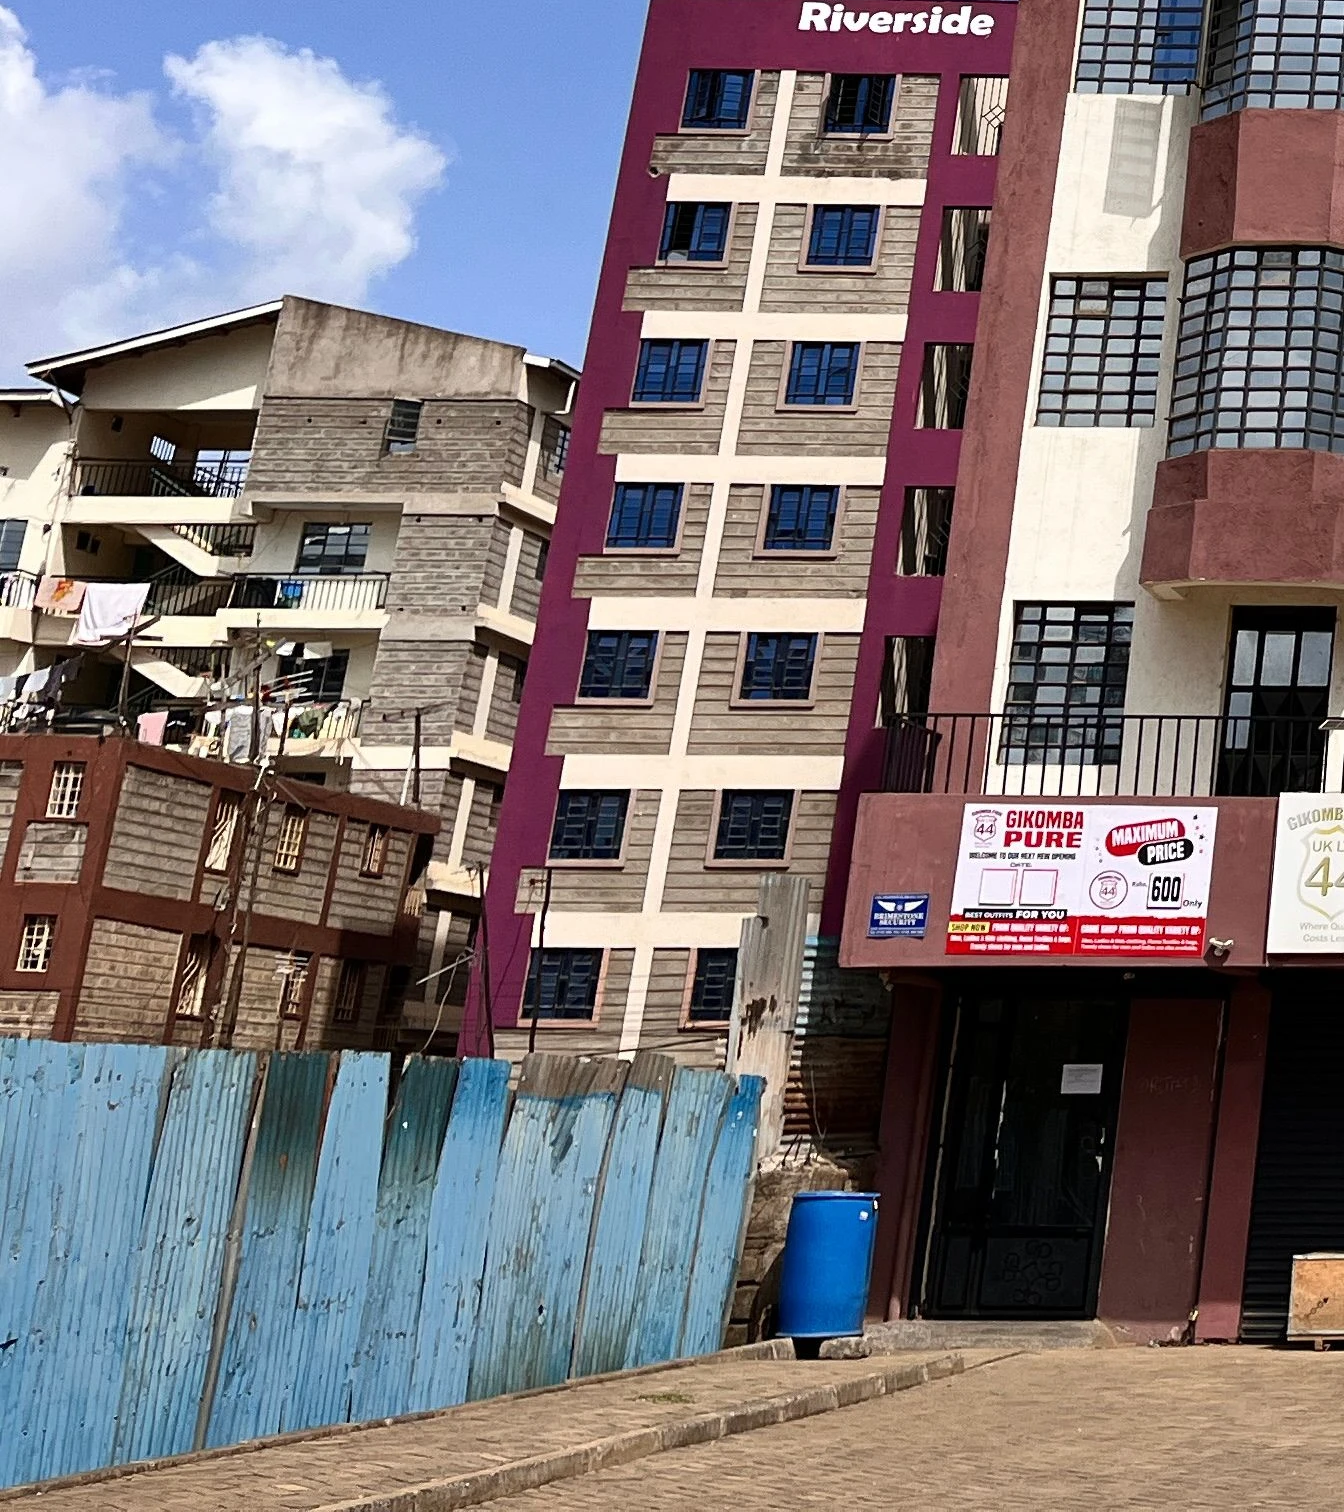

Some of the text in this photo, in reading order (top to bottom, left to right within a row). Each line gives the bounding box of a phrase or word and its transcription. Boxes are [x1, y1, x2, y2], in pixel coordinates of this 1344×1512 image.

[798, 1, 995, 36] Riverside
[1006, 810, 1084, 829] GIKOMBA
[977, 823, 994, 835] 44
[1111, 820, 1179, 847] MAXIMUM
[1003, 831, 1083, 848] PURE
[1312, 840, 1333, 852] UK
[1146, 841, 1185, 863] PRICE
[1151, 876, 1182, 902] 600
[1183, 899, 1203, 909] Only
[1015, 910, 1038, 919] FOR
[1041, 910, 1065, 920] YOU
[951, 923, 969, 931] SHOP
[971, 923, 986, 931] NOW
[1300, 922, 1328, 930] Where
[1303, 934, 1329, 942] Costs
